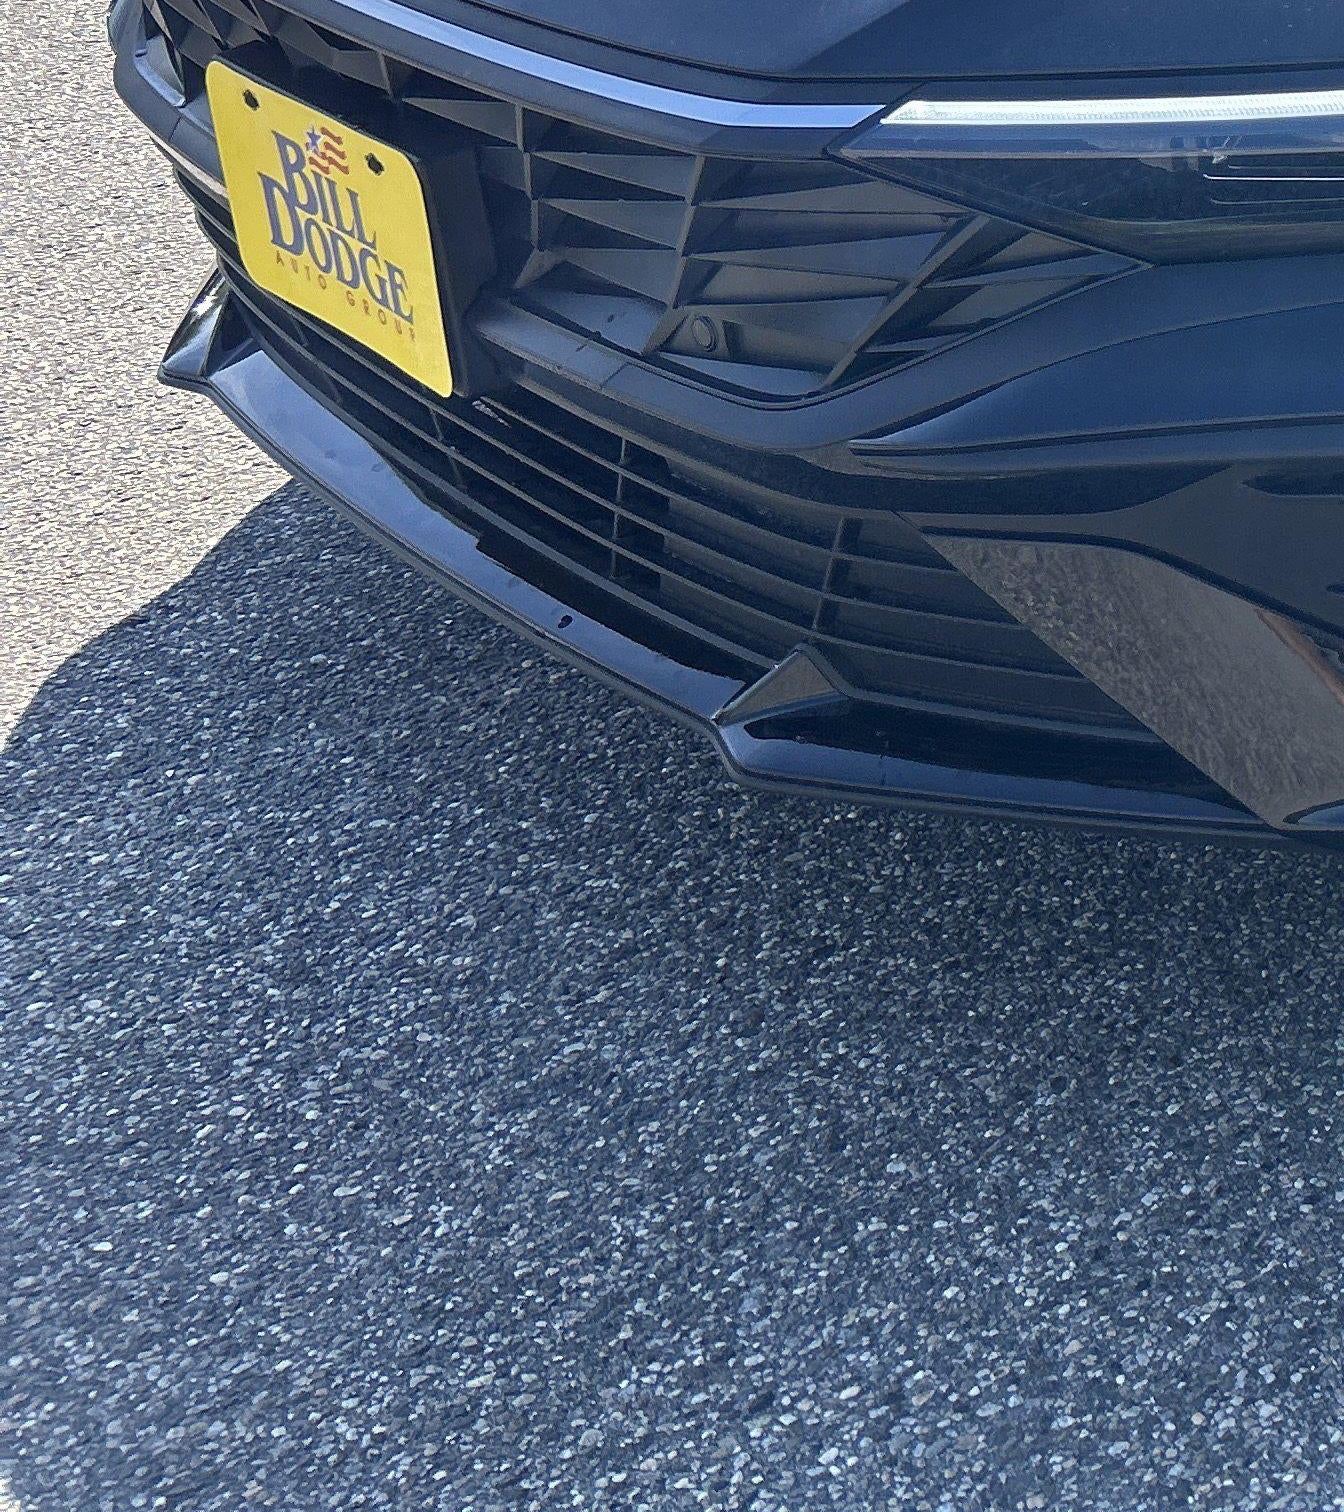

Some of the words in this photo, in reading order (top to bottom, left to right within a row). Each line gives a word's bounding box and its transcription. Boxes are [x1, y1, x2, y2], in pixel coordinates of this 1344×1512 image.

[257, 171, 414, 325] DODGE
[271, 130, 377, 251] BILL
[275, 250, 327, 290] AUTO
[346, 290, 416, 341] GROUP
